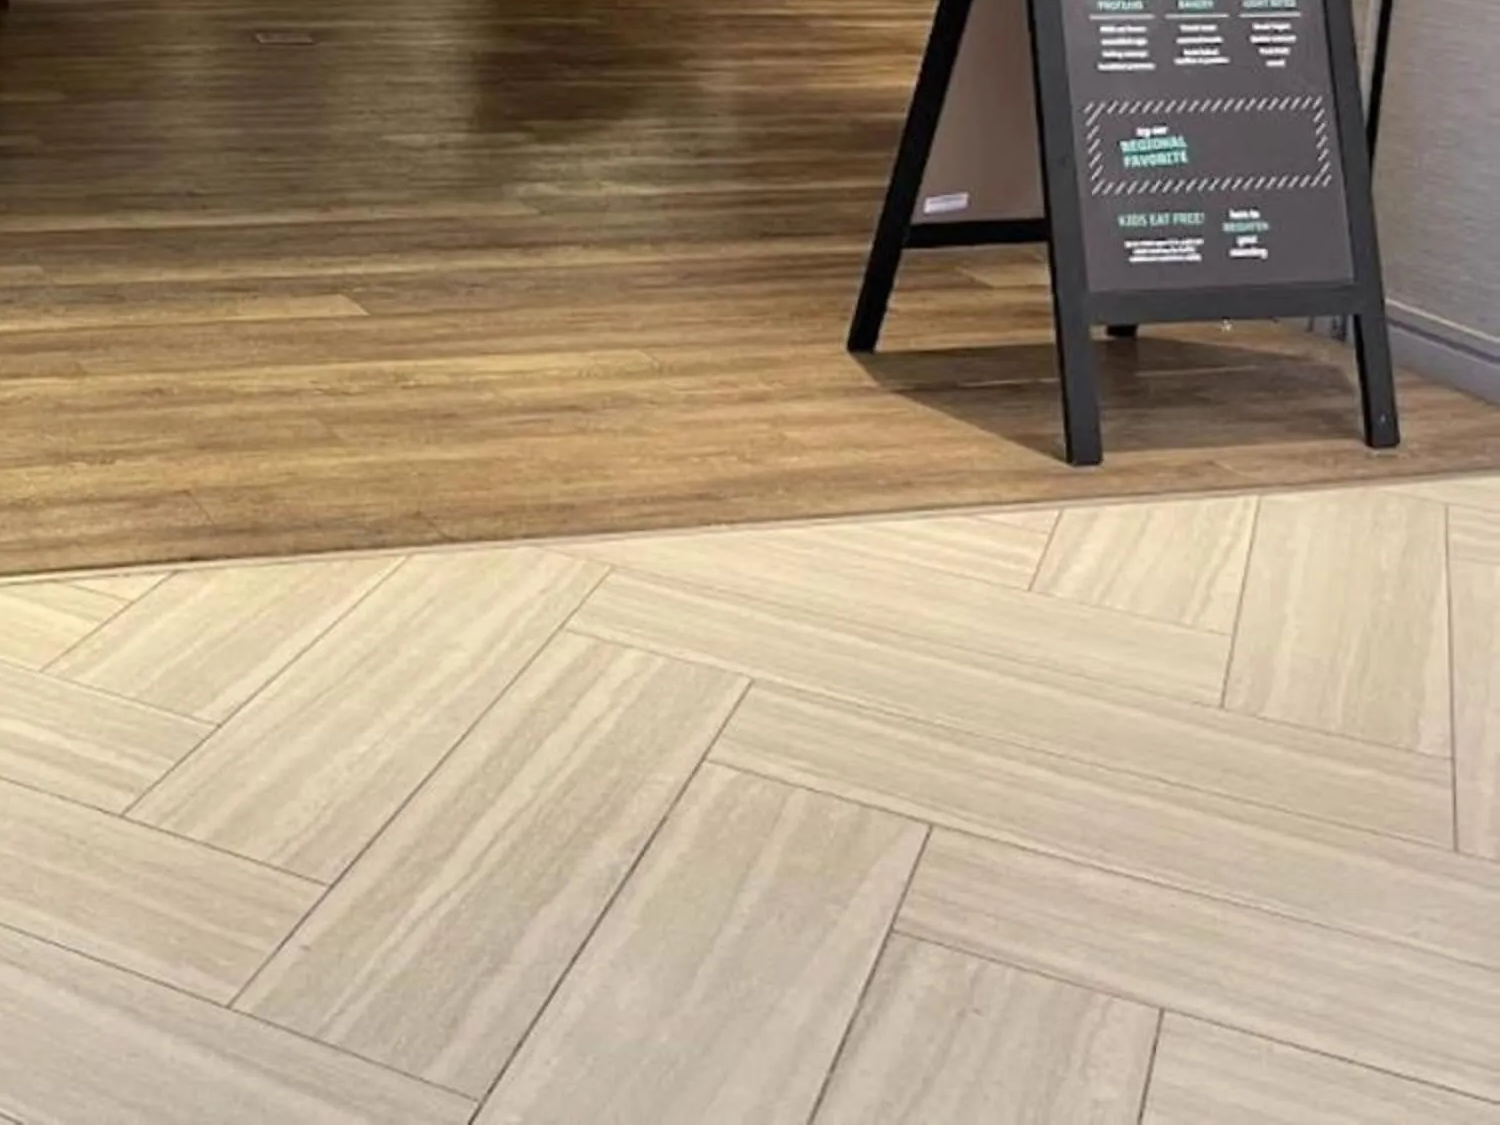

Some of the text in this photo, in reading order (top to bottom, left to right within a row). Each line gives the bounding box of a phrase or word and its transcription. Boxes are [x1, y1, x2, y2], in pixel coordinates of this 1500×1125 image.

[1120, 136, 1188, 153] REGIONAL
[1123, 150, 1189, 167] FAVORITE
[1118, 213, 1147, 227] KIDS
[1149, 213, 1170, 226] EAT
